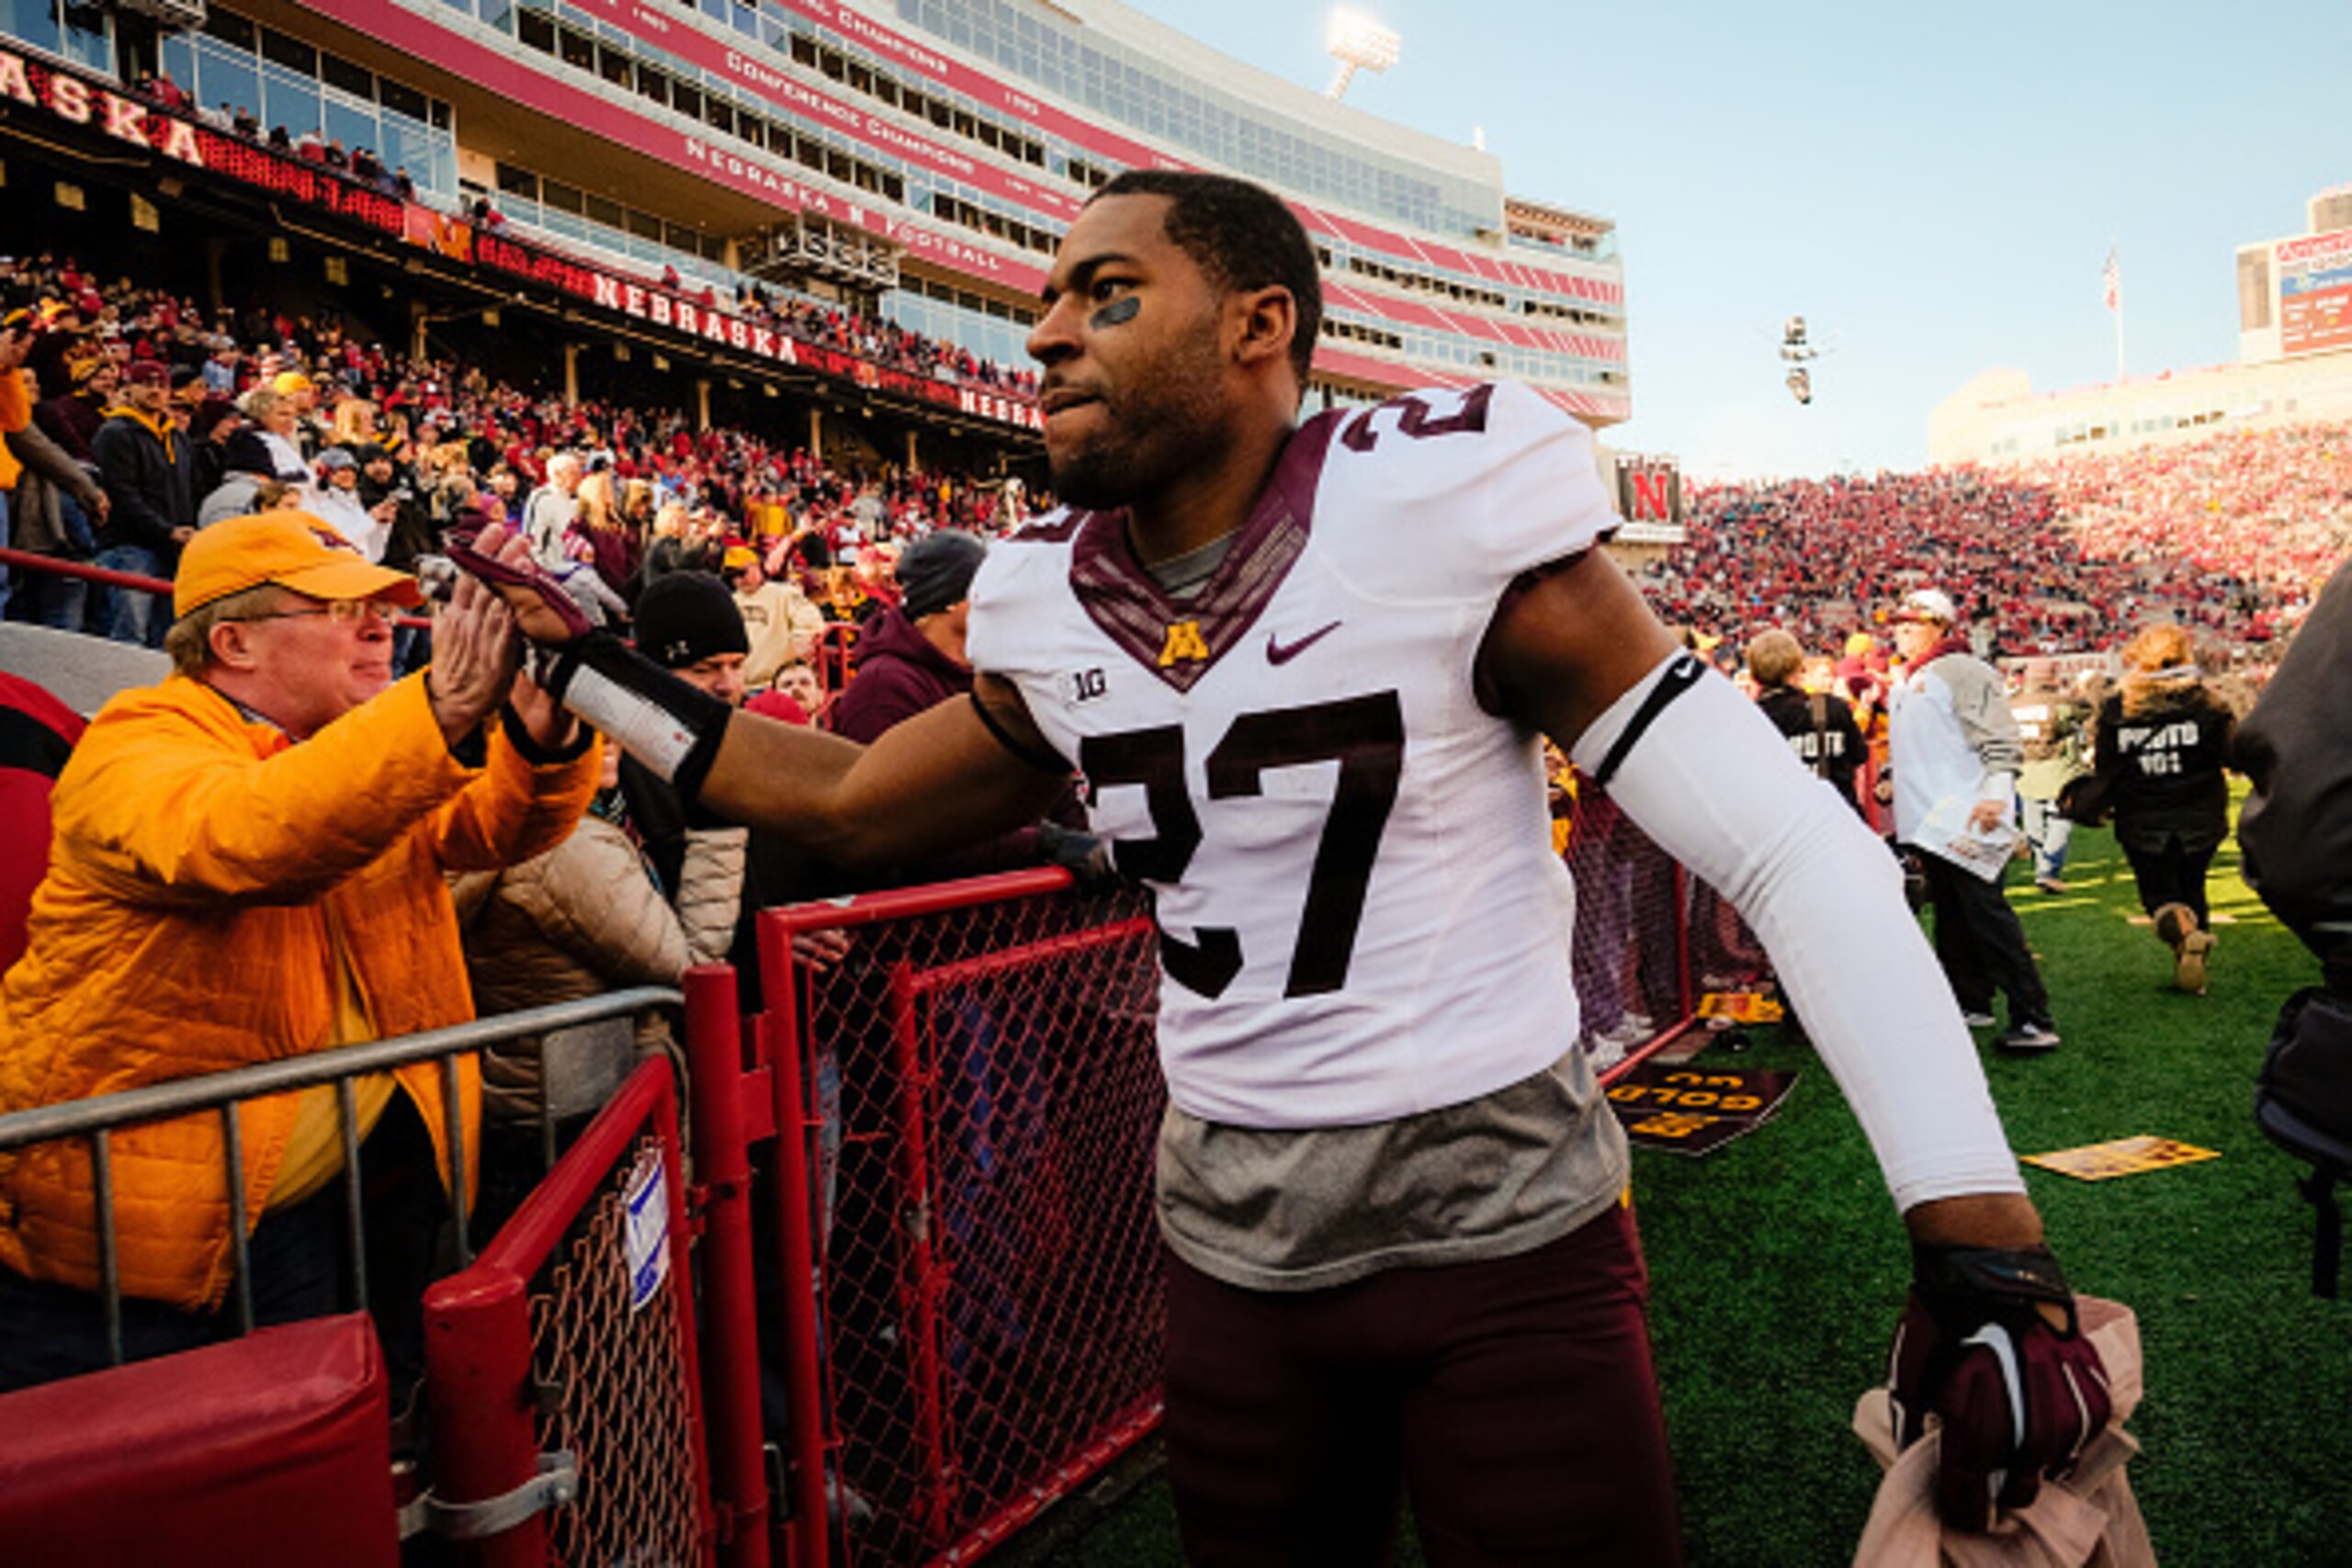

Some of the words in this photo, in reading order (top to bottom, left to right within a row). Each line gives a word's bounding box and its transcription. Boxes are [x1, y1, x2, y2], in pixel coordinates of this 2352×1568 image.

[686, 140, 830, 211] NEBRASKA
[886, 216, 1002, 271] FOOTBALL
[594, 274, 797, 364] NEBRASKA
[1633, 472, 1668, 521] N
[1080, 689, 1407, 1001] 27
[1607, 1084, 1763, 1111] GOLD
